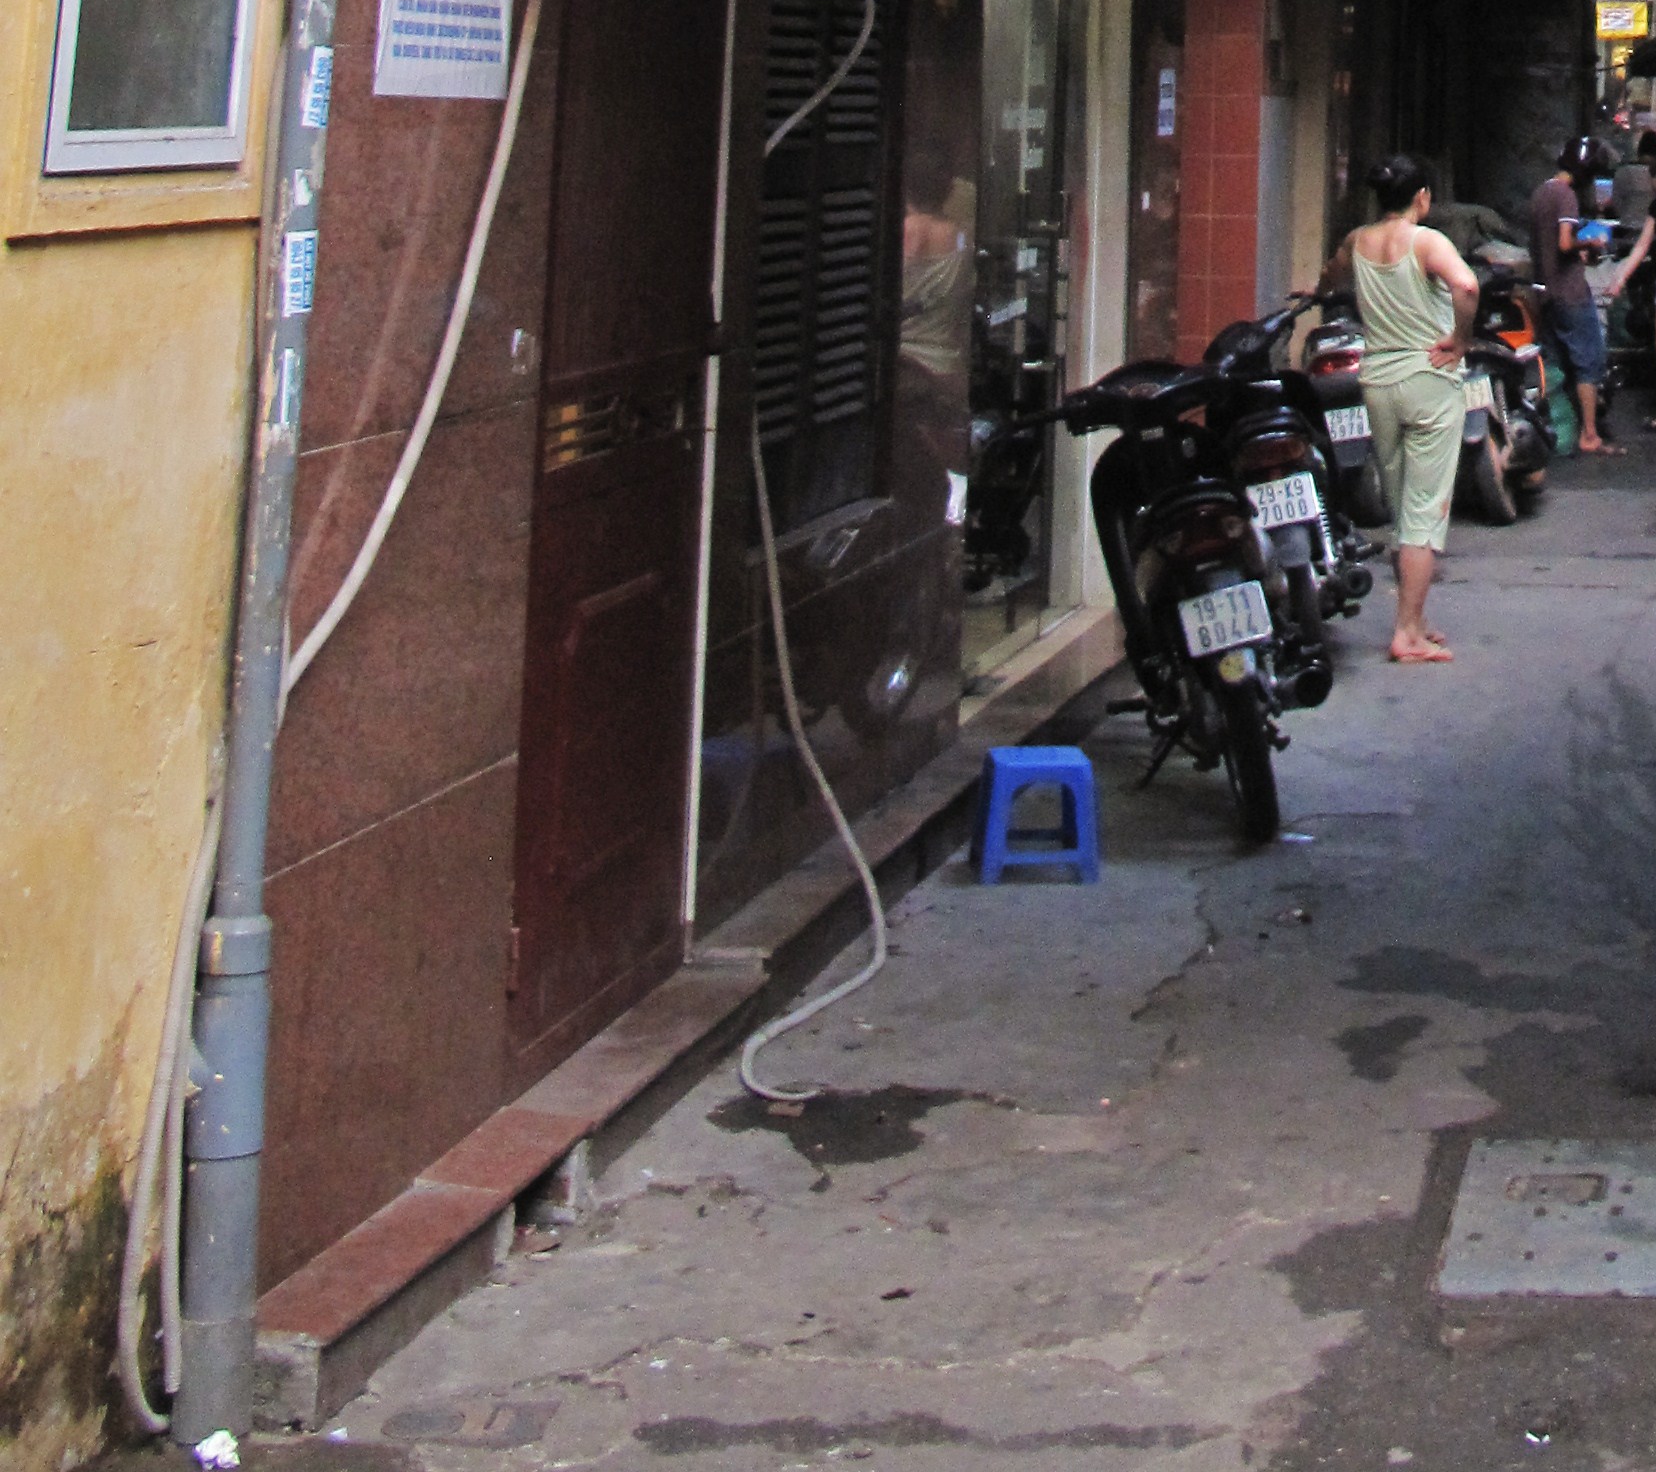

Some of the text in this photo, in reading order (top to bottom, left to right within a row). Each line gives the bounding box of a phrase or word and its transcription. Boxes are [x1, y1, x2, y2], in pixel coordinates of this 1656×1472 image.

[1256, 477, 1305, 505] 29-K9
[1261, 498, 1309, 526] 7000
[1198, 613, 1260, 649] 8044
